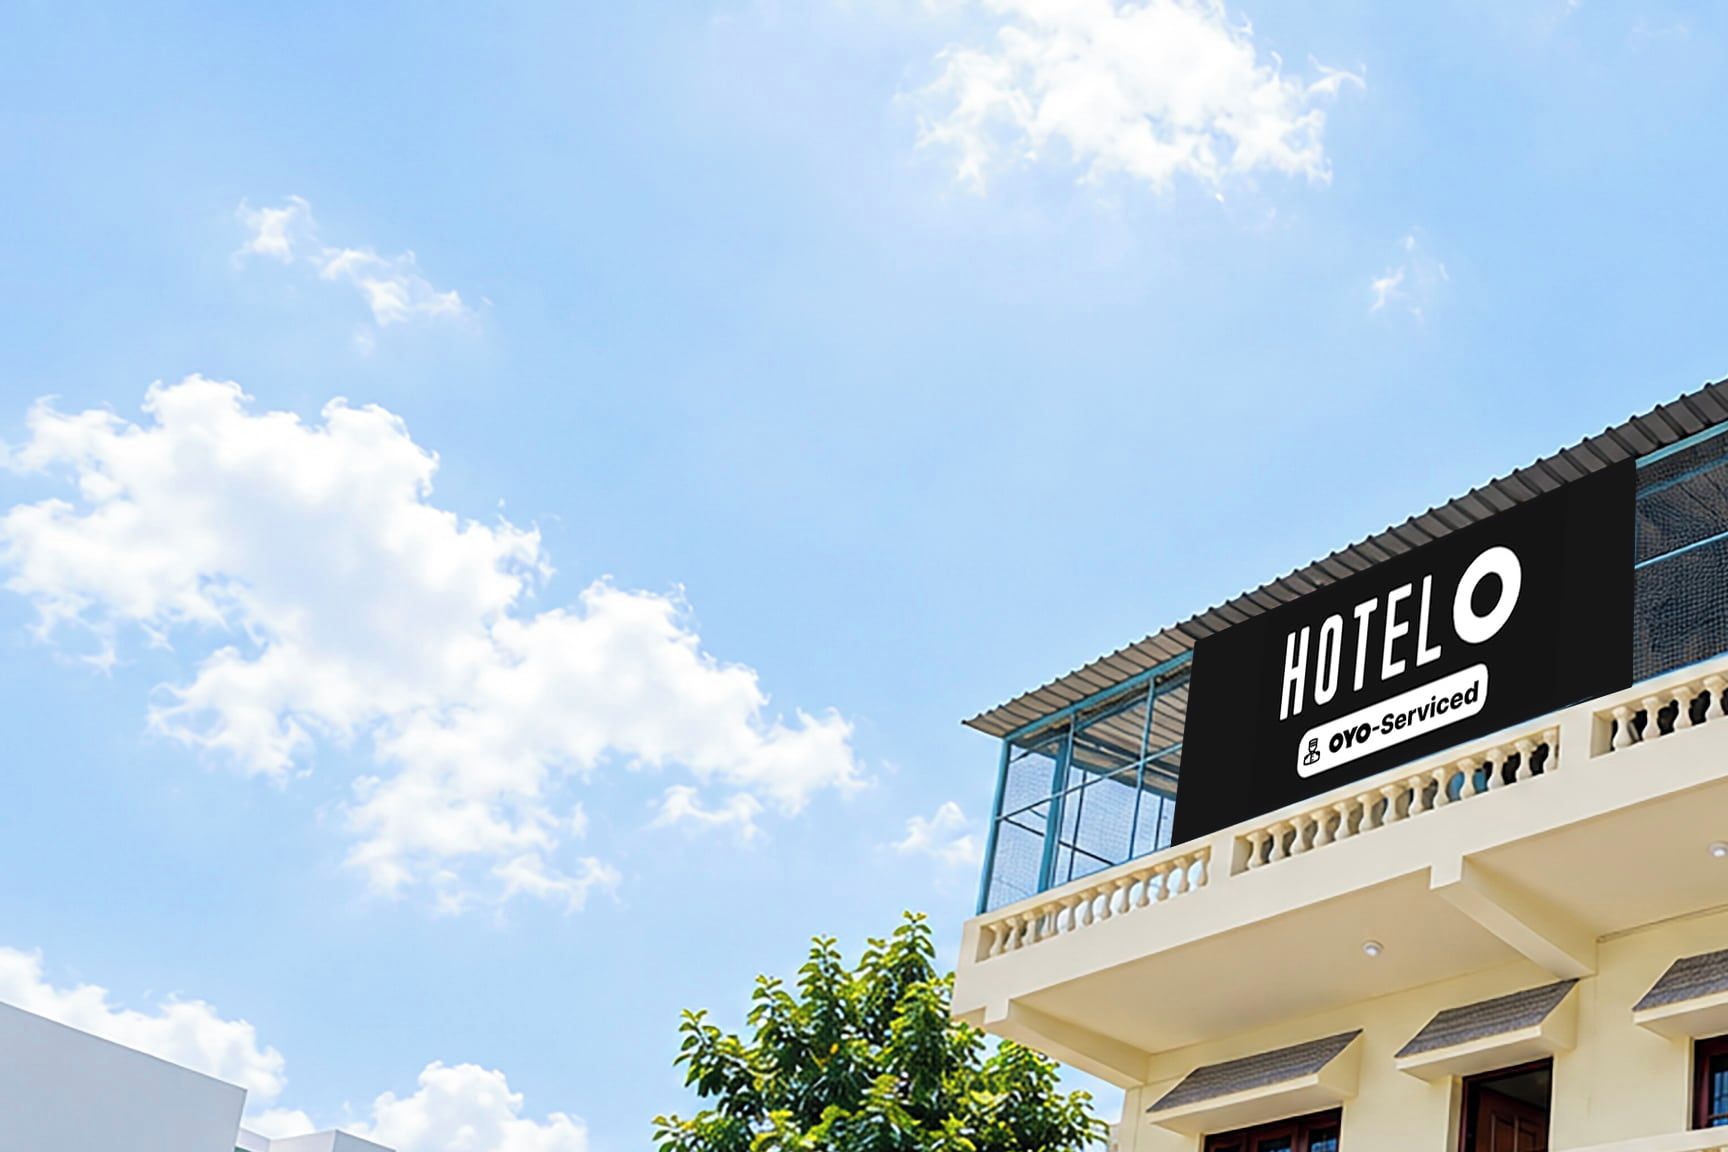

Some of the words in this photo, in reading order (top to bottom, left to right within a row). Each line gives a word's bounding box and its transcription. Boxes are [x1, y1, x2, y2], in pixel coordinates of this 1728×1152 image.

[1279, 574, 1442, 721] HOTEL
[1453, 546, 1522, 644] O
[1328, 680, 1480, 754] OYO-Serviced
